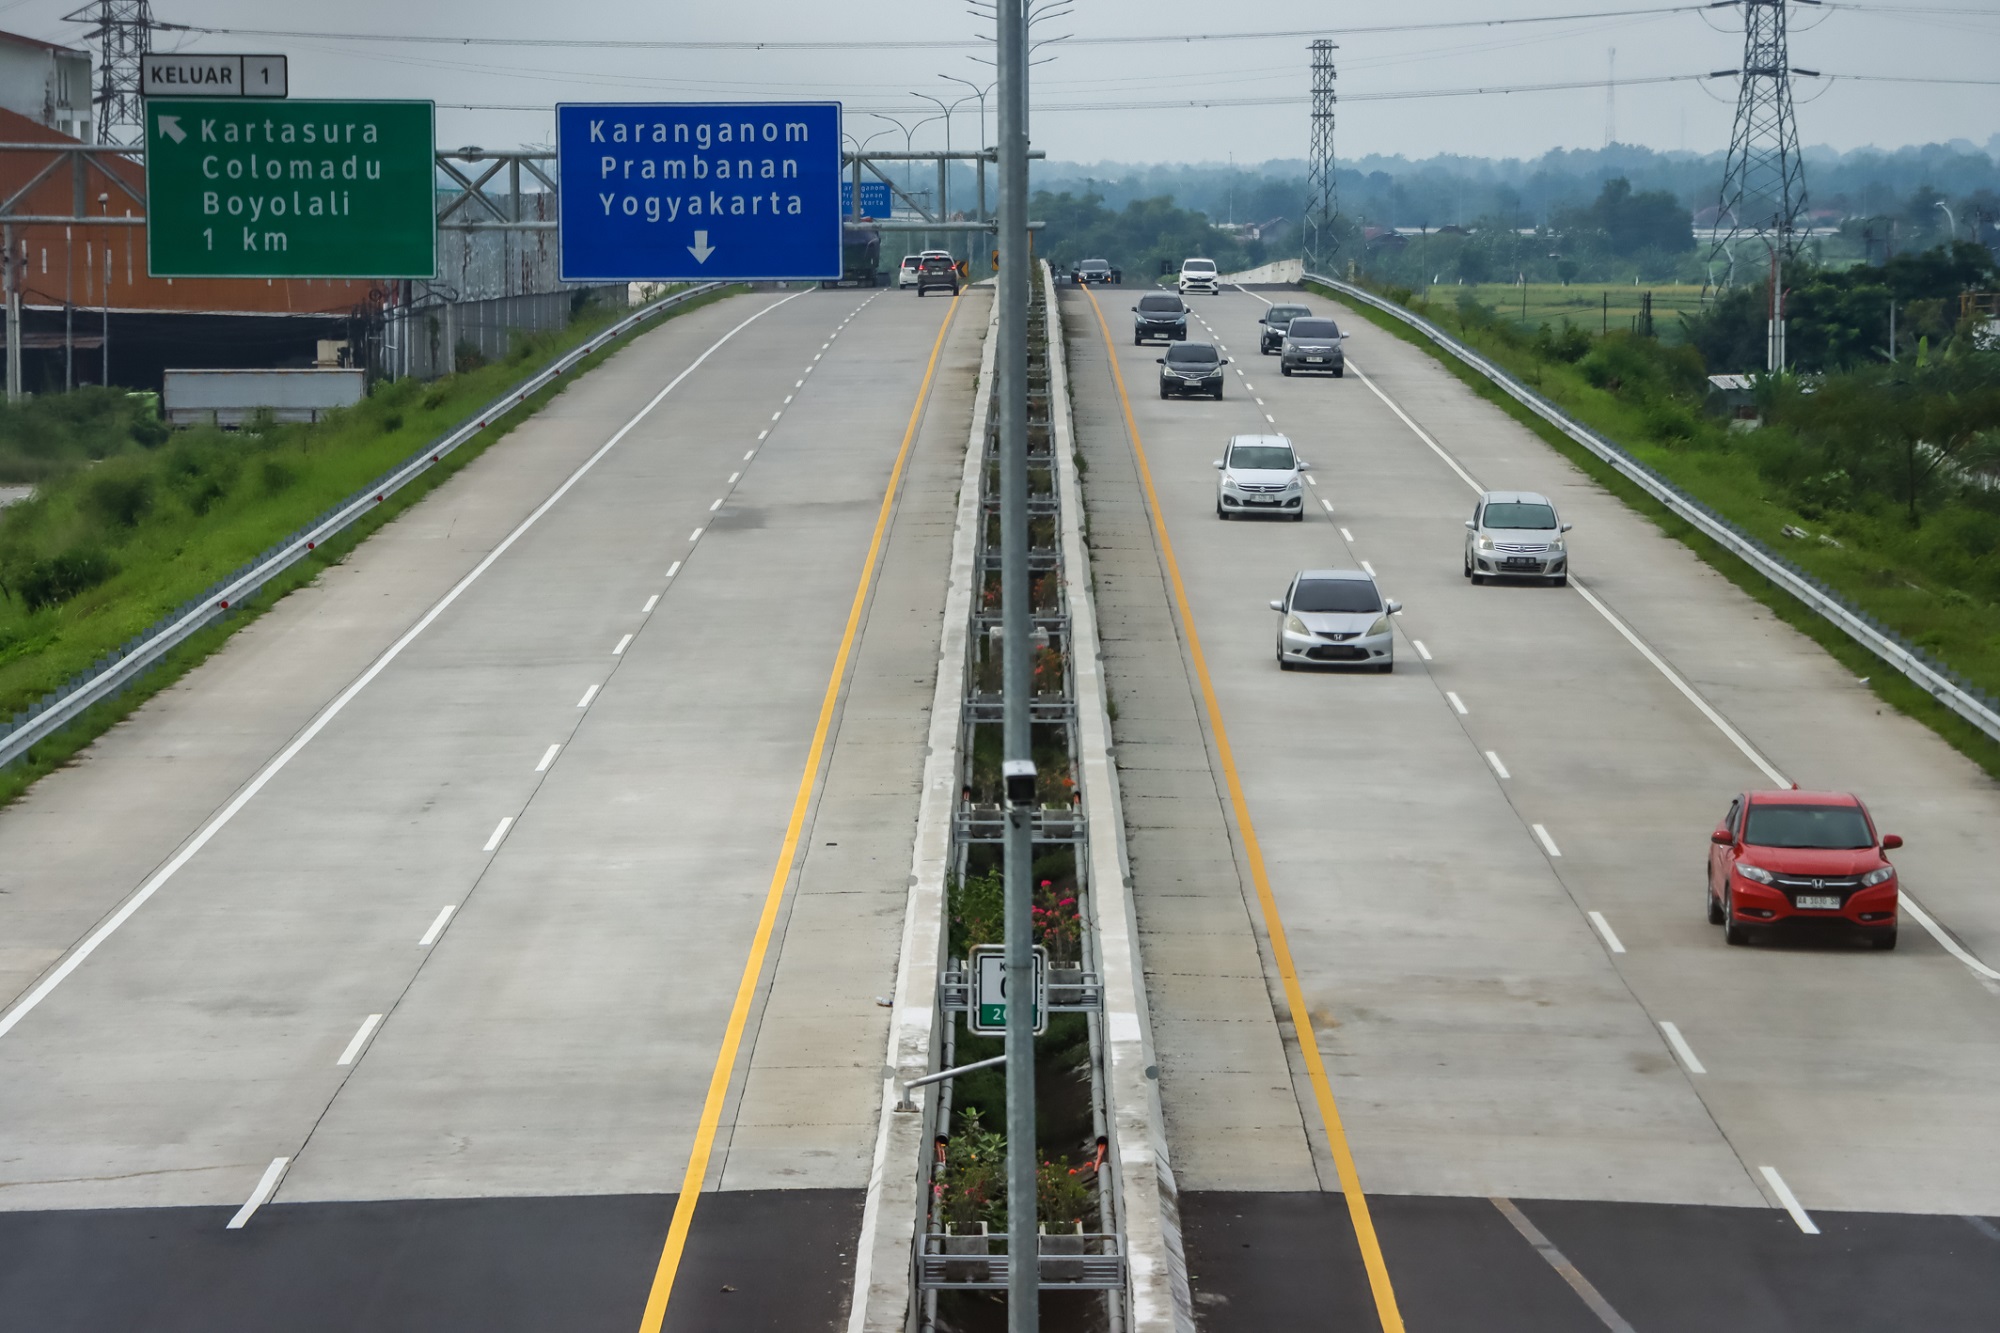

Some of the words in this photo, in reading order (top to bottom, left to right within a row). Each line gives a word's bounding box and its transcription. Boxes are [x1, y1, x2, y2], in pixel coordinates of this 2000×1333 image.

[151, 66, 232, 85] KELUAR
[260, 67, 269, 85] 1
[201, 118, 378, 144] Kartasura
[590, 119, 808, 150] Karanganom
[202, 153, 381, 180] Colomadu
[601, 154, 798, 180] Prambanan
[203, 190, 350, 223] Boyolali
[599, 190, 802, 223] Yogyakarta
[203, 228, 213, 251] 1
[243, 226, 288, 251] km
